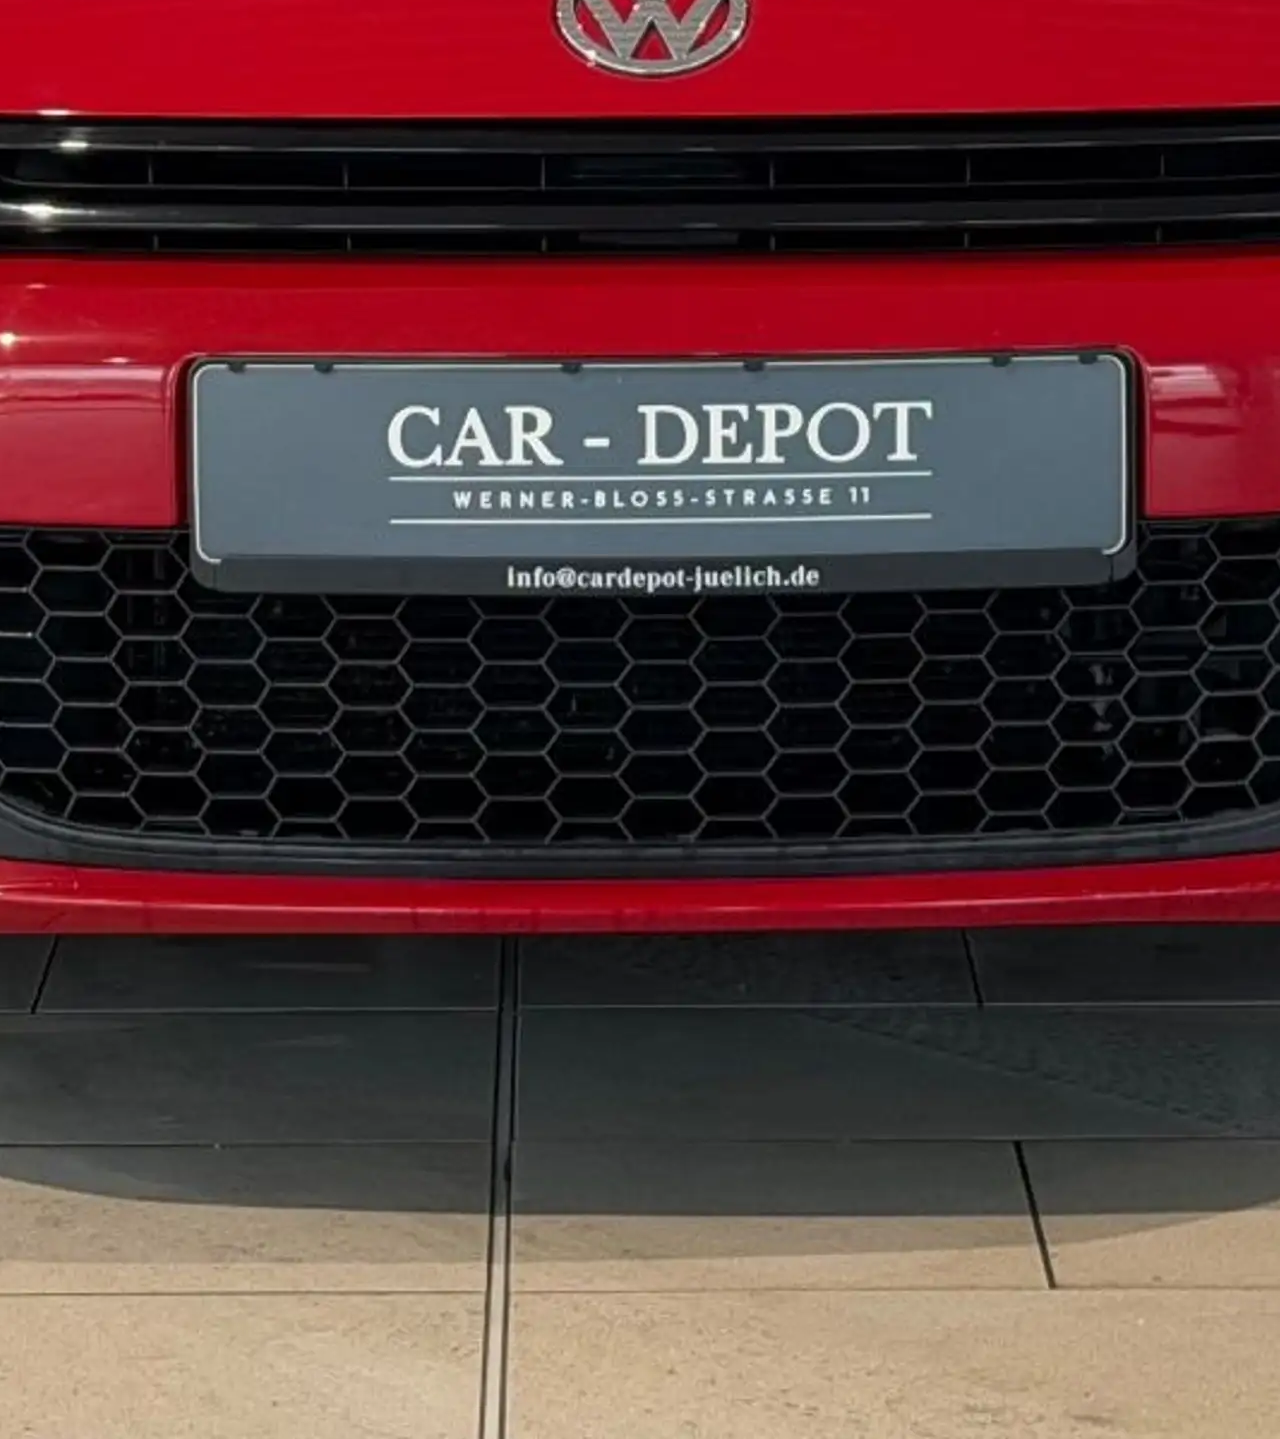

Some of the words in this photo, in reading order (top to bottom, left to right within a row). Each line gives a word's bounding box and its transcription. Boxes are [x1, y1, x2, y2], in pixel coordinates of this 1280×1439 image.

[387, 404, 564, 468] CAR
[583, 435, 611, 449] -
[636, 400, 933, 466] DEPOT
[452, 487, 833, 510] WERNER-BLOSS-STRASSE
[848, 486, 871, 504] 11
[506, 564, 821, 594] info@cardepot-juelich.de
